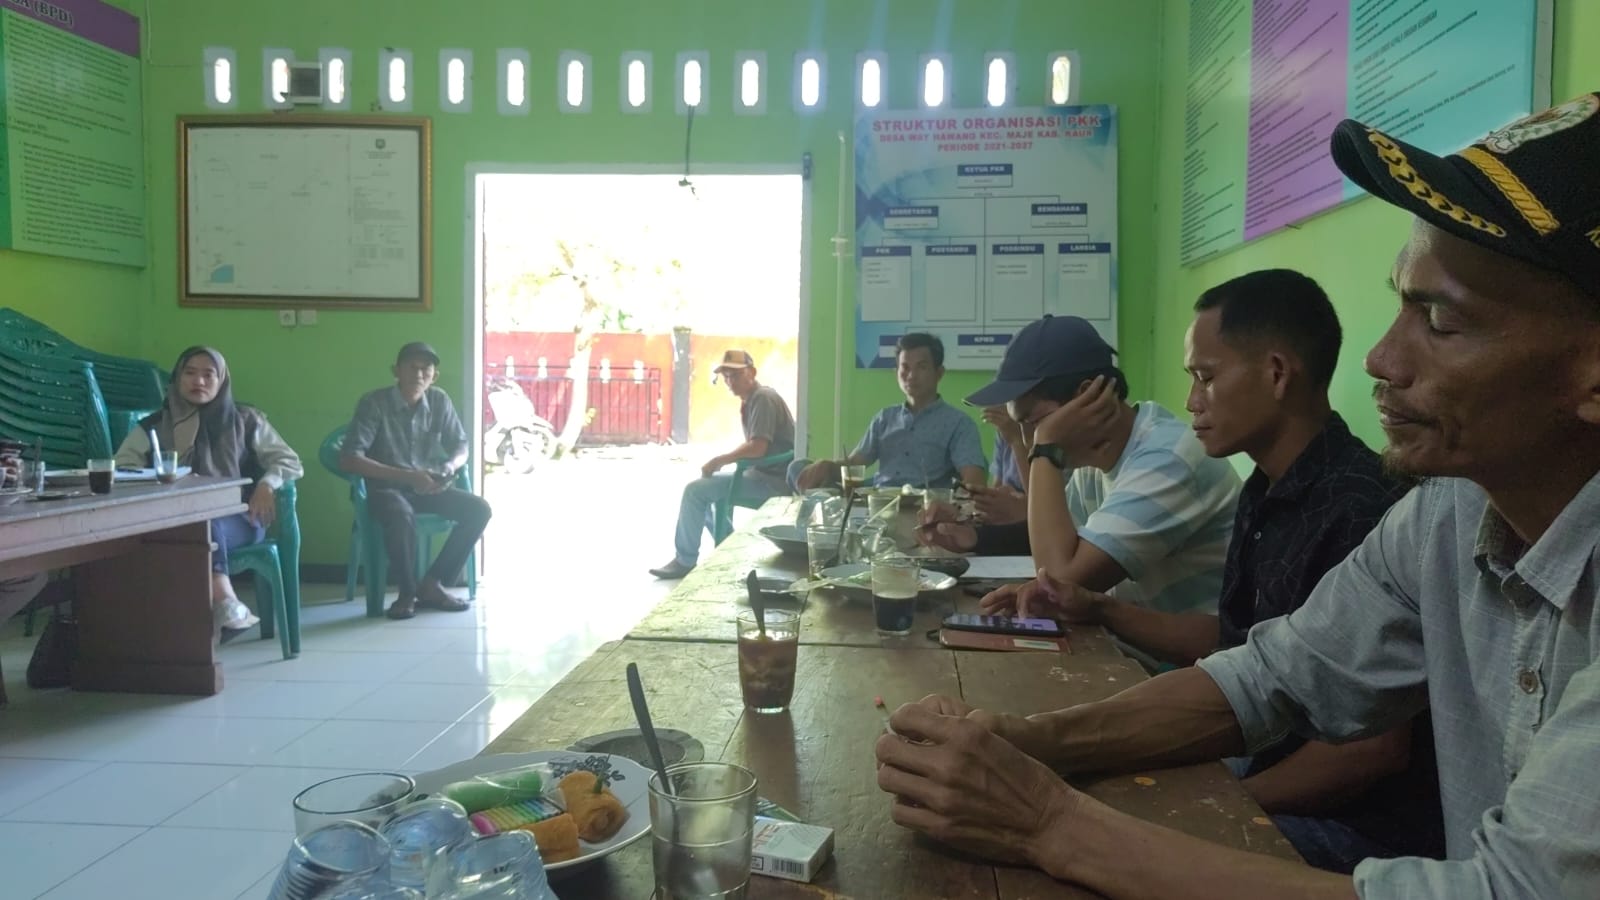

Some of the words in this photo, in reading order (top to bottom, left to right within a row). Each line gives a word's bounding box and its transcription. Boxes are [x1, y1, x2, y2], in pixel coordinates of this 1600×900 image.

[873, 119, 957, 132] STRUKTUR
[963, 116, 1061, 130] ORGANISASI
[1068, 114, 1100, 126] PKK
[880, 133, 905, 142] DESA
[980, 130, 1003, 140] KEC.
[1007, 130, 1034, 139] MAJE
[938, 143, 980, 152] PERIODE
[984, 142, 1033, 151] 2021-2027
[1037, 205, 1080, 213] BENDAHARA
[1070, 244, 1097, 252] LANSIA
